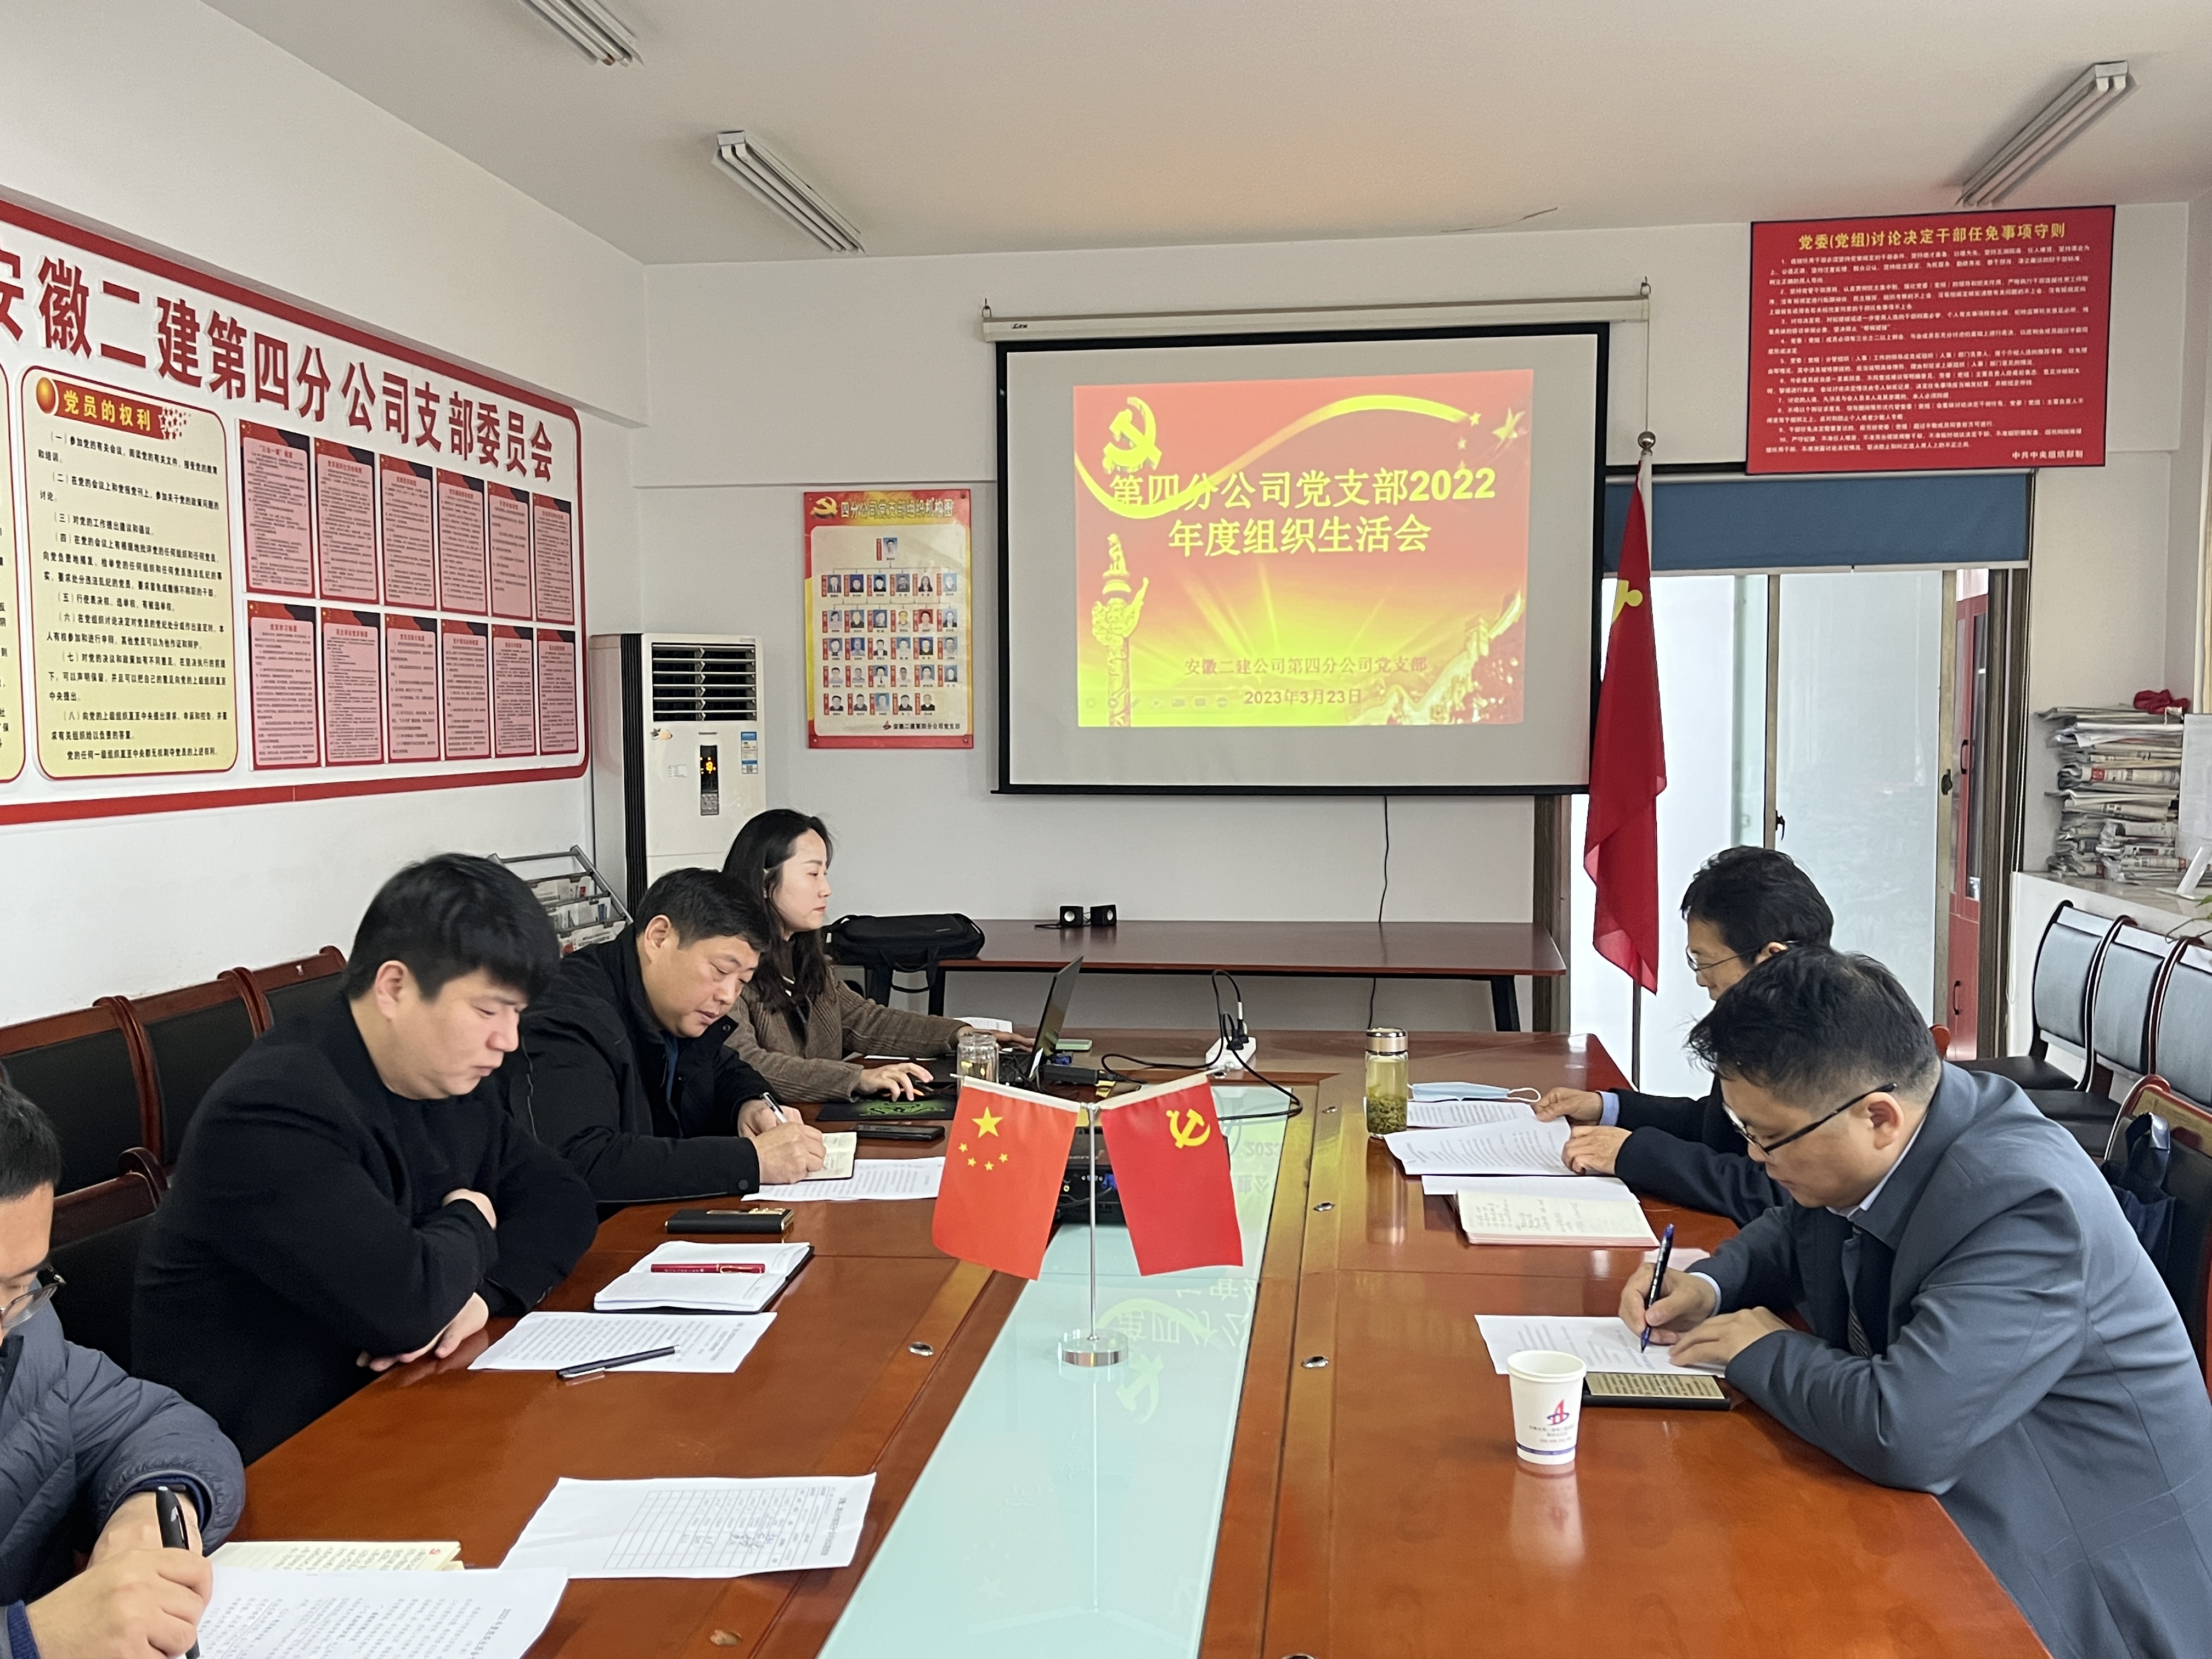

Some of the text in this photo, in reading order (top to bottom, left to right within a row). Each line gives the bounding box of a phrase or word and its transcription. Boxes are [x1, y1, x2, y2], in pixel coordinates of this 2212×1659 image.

[1799, 223, 2066, 250] 党委(党组)讨论决定干部任免事项守则
[63, 389, 151, 431] 党员的权利
[1109, 466, 1497, 511] 第四分公司党支部2022
[1167, 514, 1432, 558] 年度组织生活会
[1183, 656, 1428, 676] 安徽二建公司第四分公司党支部
[1243, 689, 1363, 706] 2023年3月23日
